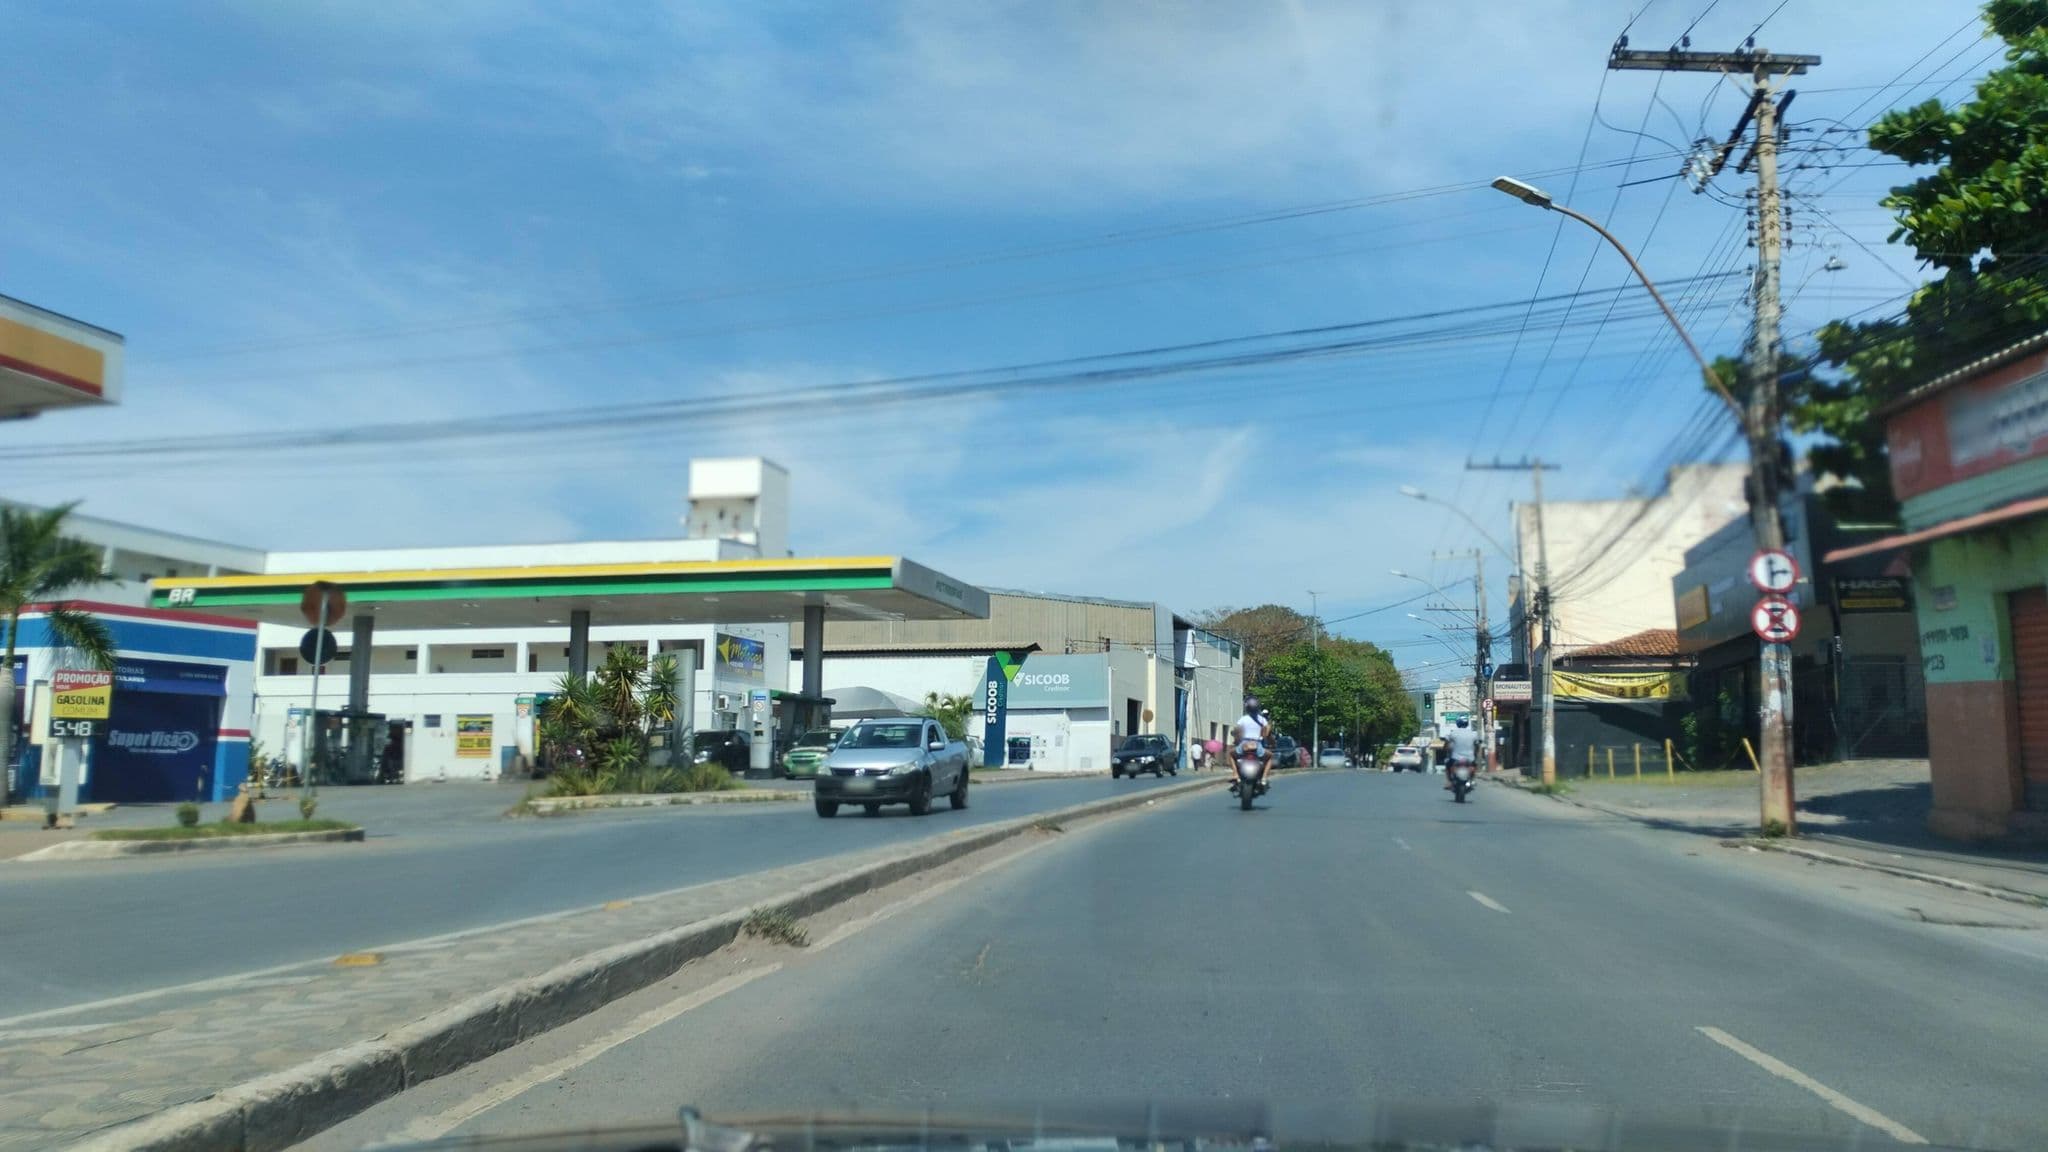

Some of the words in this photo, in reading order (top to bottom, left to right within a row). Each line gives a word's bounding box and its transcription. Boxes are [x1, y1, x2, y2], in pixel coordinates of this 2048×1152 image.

[168, 589, 196, 602] BR
[56, 671, 110, 686] PROMOÇÃO
[1024, 674, 1070, 685] SICOOB
[56, 695, 105, 705] GASOLINA
[987, 681, 998, 724] SICOOB
